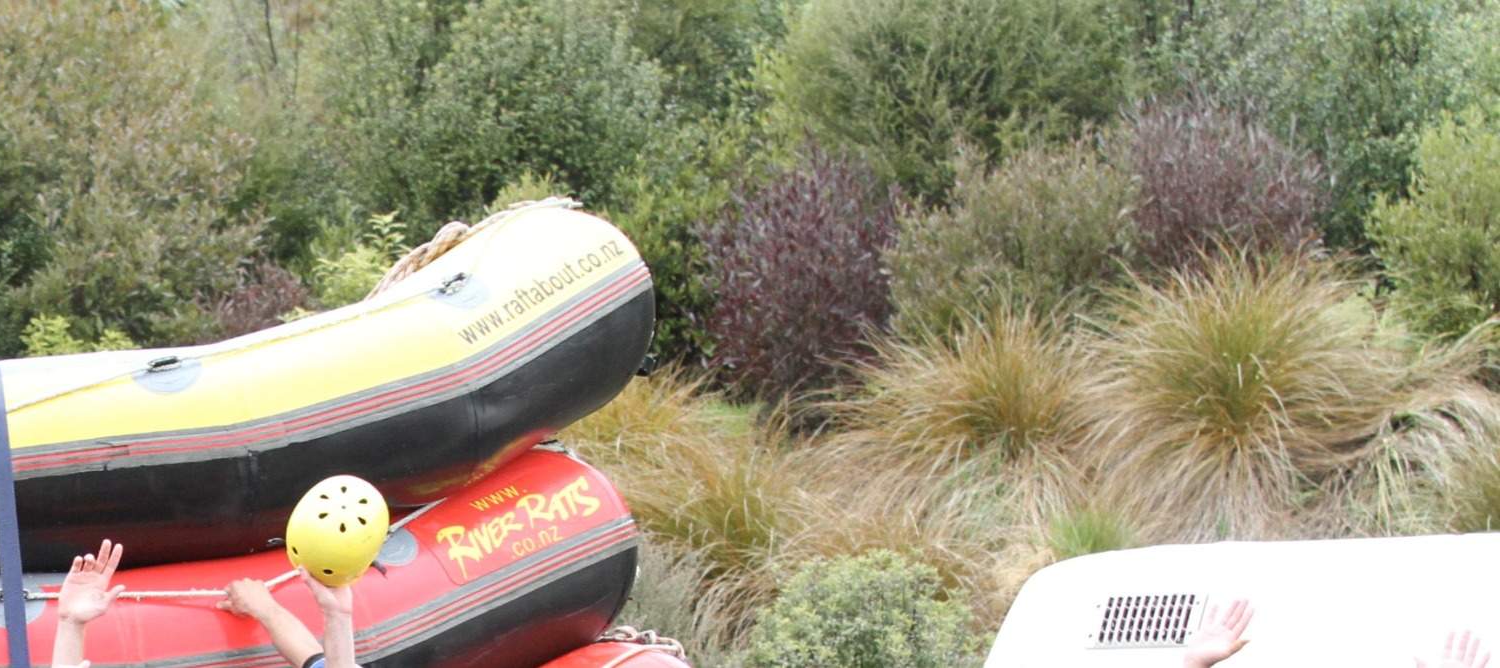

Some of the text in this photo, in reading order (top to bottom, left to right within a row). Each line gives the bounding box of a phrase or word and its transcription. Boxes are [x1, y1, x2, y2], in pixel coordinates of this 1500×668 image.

[458, 240, 624, 345] www.raftabout.co.nz
[436, 475, 601, 579] RIVER RATS
